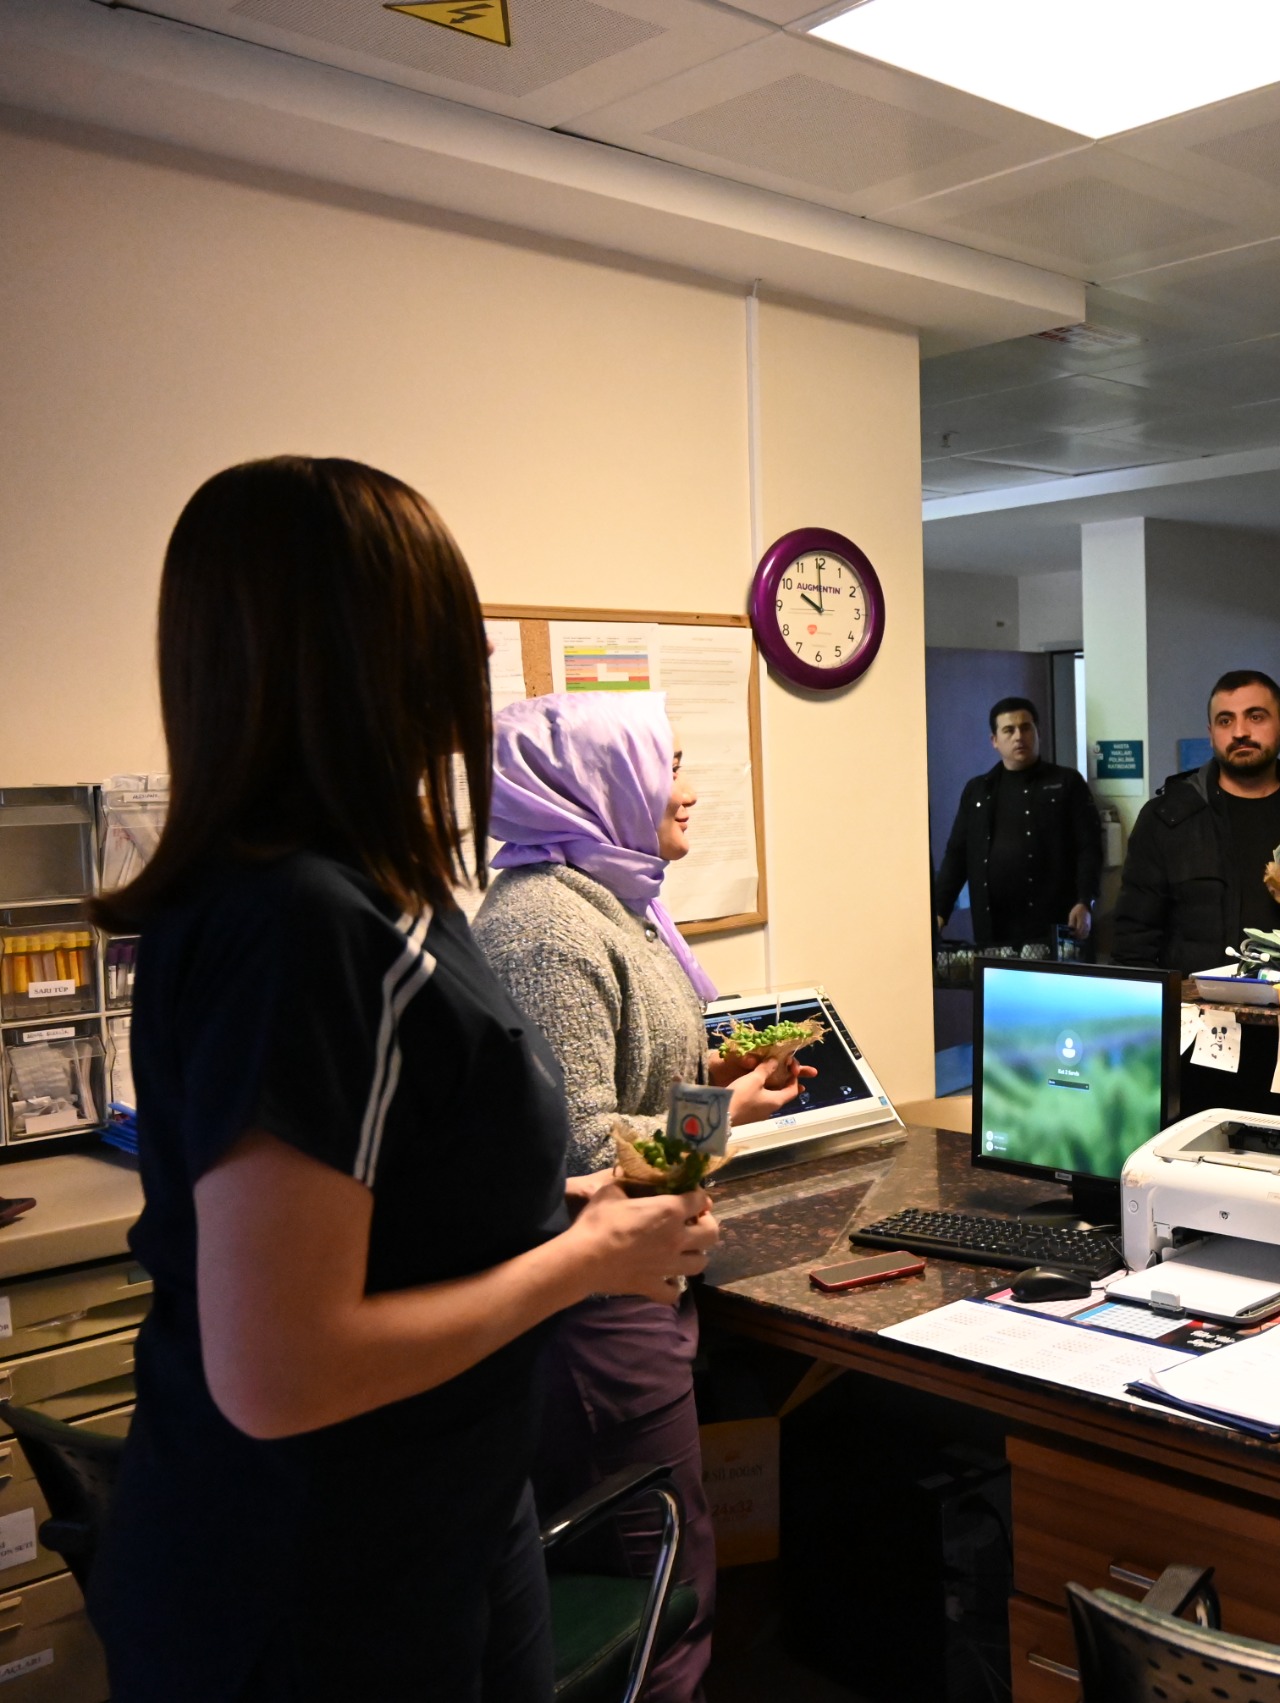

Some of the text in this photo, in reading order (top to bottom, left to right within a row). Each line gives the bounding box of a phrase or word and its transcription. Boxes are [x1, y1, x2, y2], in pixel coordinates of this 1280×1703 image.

[796, 562, 804, 573] 11
[815, 558, 826, 570] 12
[837, 568, 842, 578] 1
[782, 578, 793, 590] 10
[797, 583, 841, 594] AUGMENTIN
[849, 586, 856, 598] 2
[776, 600, 783, 611] 9
[854, 608, 861, 620] 3
[782, 624, 790, 636] 8
[847, 631, 855, 642] 4
[796, 642, 803, 654] 7
[834, 646, 842, 658] 5
[815, 651, 822, 663] 6
